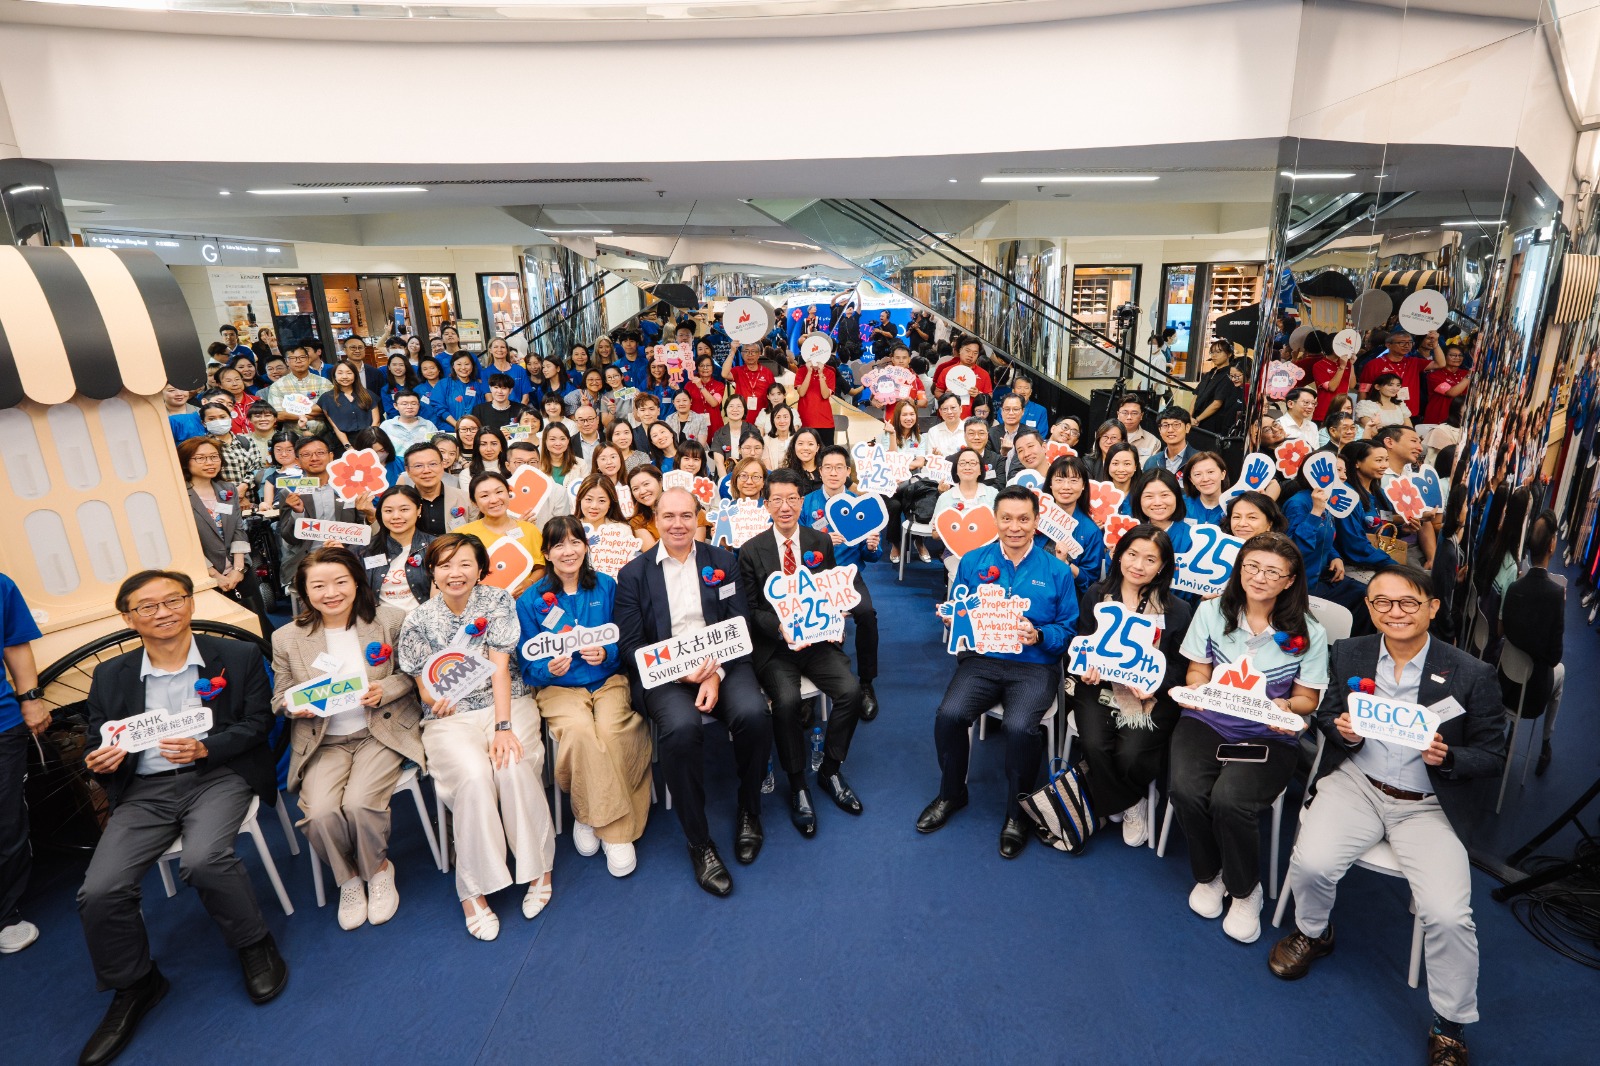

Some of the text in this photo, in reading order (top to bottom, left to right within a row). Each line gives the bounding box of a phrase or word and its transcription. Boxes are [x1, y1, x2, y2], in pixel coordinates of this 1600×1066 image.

[202, 244, 218, 263] G
[854, 443, 912, 464] CHARITY
[927, 456, 942, 471] 25
[283, 479, 313, 487] YWCA
[1047, 505, 1076, 531] YEARS
[328, 523, 365, 536] Coca-Cola
[600, 527, 621, 537] Swire
[1046, 524, 1066, 542] WITH
[590, 545, 632, 557] Community
[601, 537, 640, 548] Properties
[768, 568, 853, 600] CHARITY
[979, 585, 1004, 597] Swire
[801, 597, 842, 631] 25th
[981, 597, 1029, 612] Properties
[971, 609, 1021, 621] Community
[527, 627, 615, 657] cityplaza
[673, 623, 741, 659] 太古地產
[1095, 605, 1160, 674] 25th
[648, 642, 745, 683] SWIRE PROPERTIES
[303, 681, 355, 702] YWCA
[1203, 686, 1272, 711] 義務工作發展局
[1179, 691, 1296, 726] AGENCY FOR VOLUNTEER SERVICE
[1356, 697, 1429, 733] BGCA
[127, 714, 163, 732] SAHK
